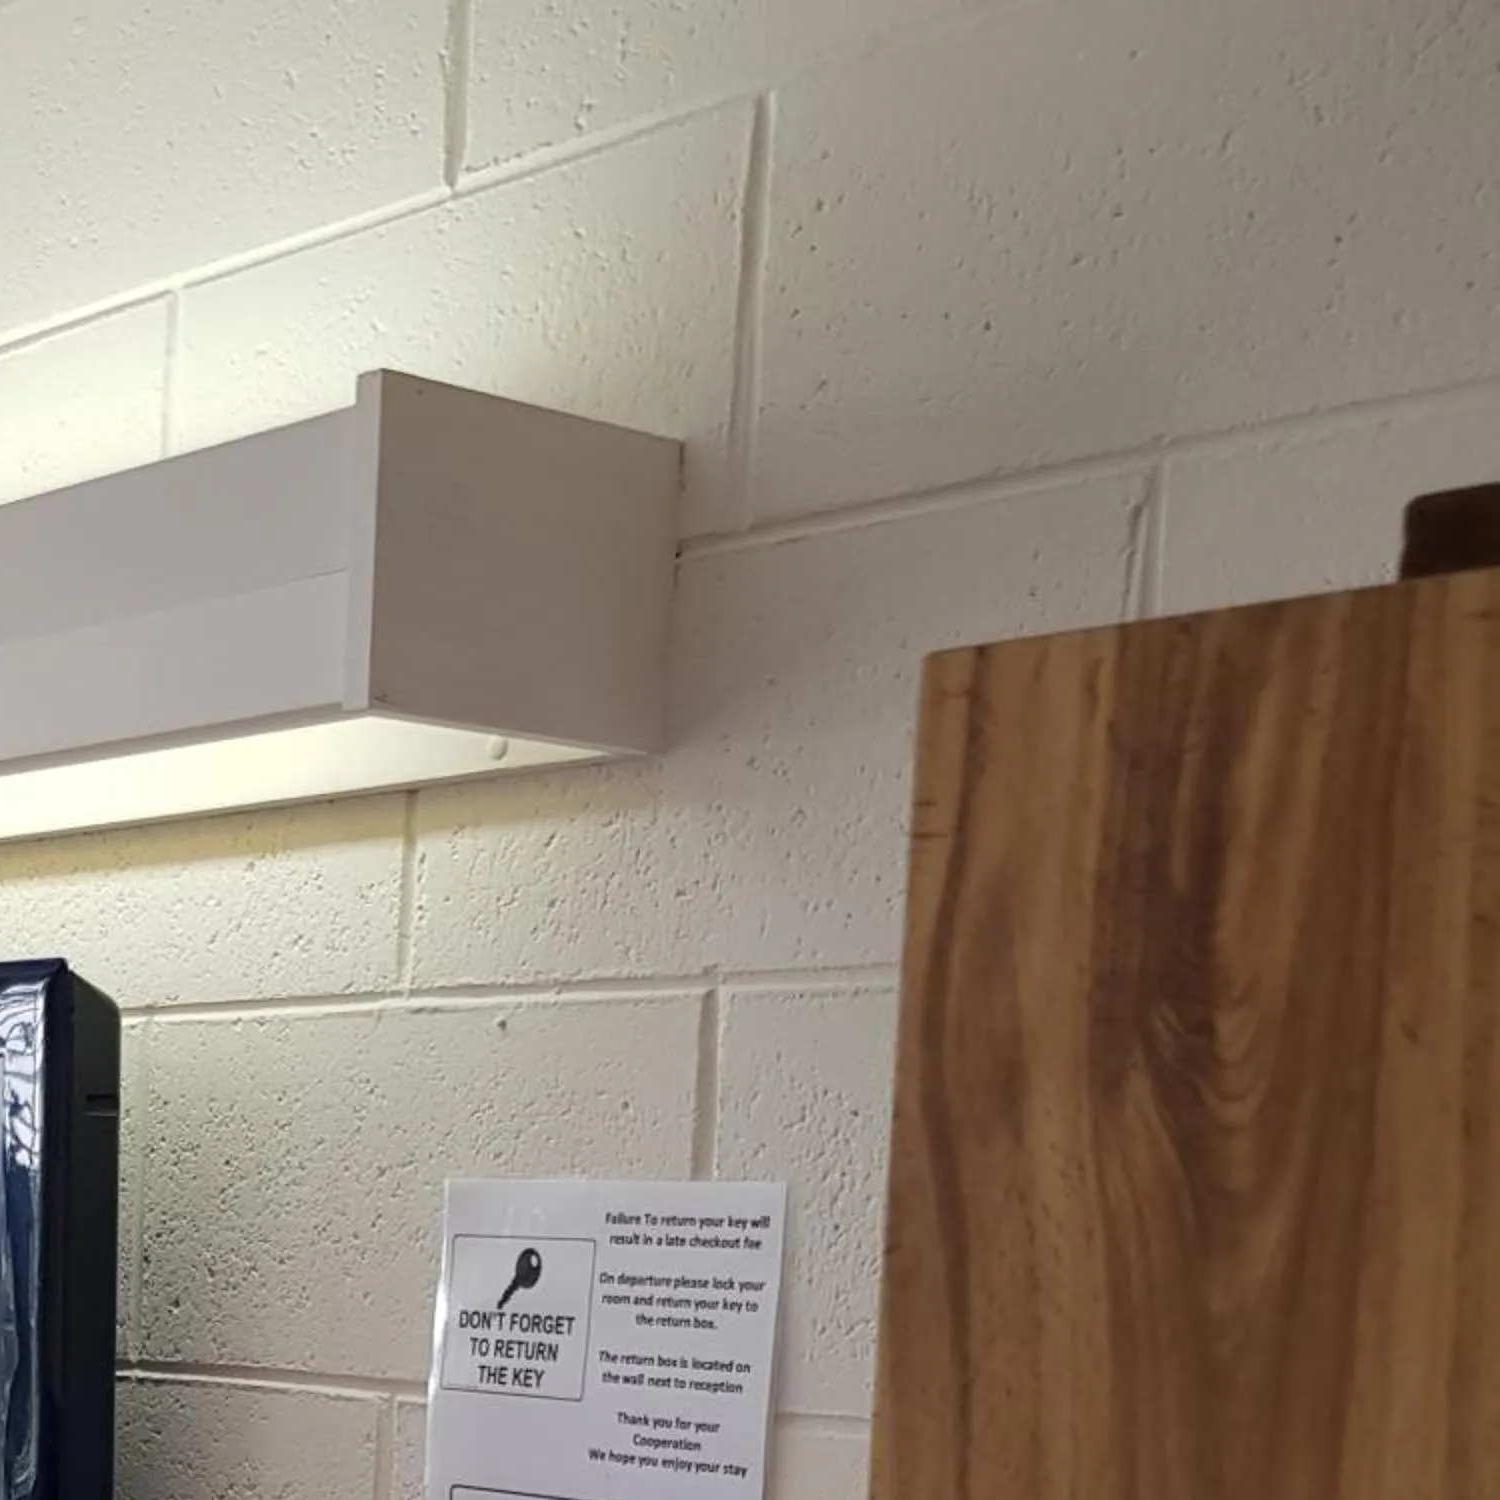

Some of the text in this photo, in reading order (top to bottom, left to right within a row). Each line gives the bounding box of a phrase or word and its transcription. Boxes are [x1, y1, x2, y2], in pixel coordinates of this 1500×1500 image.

[605, 1212, 771, 1231] Failure To return your key will
[609, 1234, 762, 1249] result in a late checkout fee
[599, 1272, 765, 1292] On departure please lock your
[601, 1294, 758, 1313] room and return your key to
[459, 1310, 575, 1336] DON'T FORGET
[635, 1314, 654, 1326] the
[656, 1317, 691, 1328] return
[469, 1336, 559, 1361] TO RETURN
[599, 1350, 751, 1373] The return box is located on
[477, 1364, 545, 1388] THE KEY
[602, 1371, 743, 1394] the wall next to reception
[617, 1411, 720, 1434] Thank you for your
[633, 1434, 701, 1452] Cooperation
[588, 1449, 748, 1478] We hope you enjoy your stay
